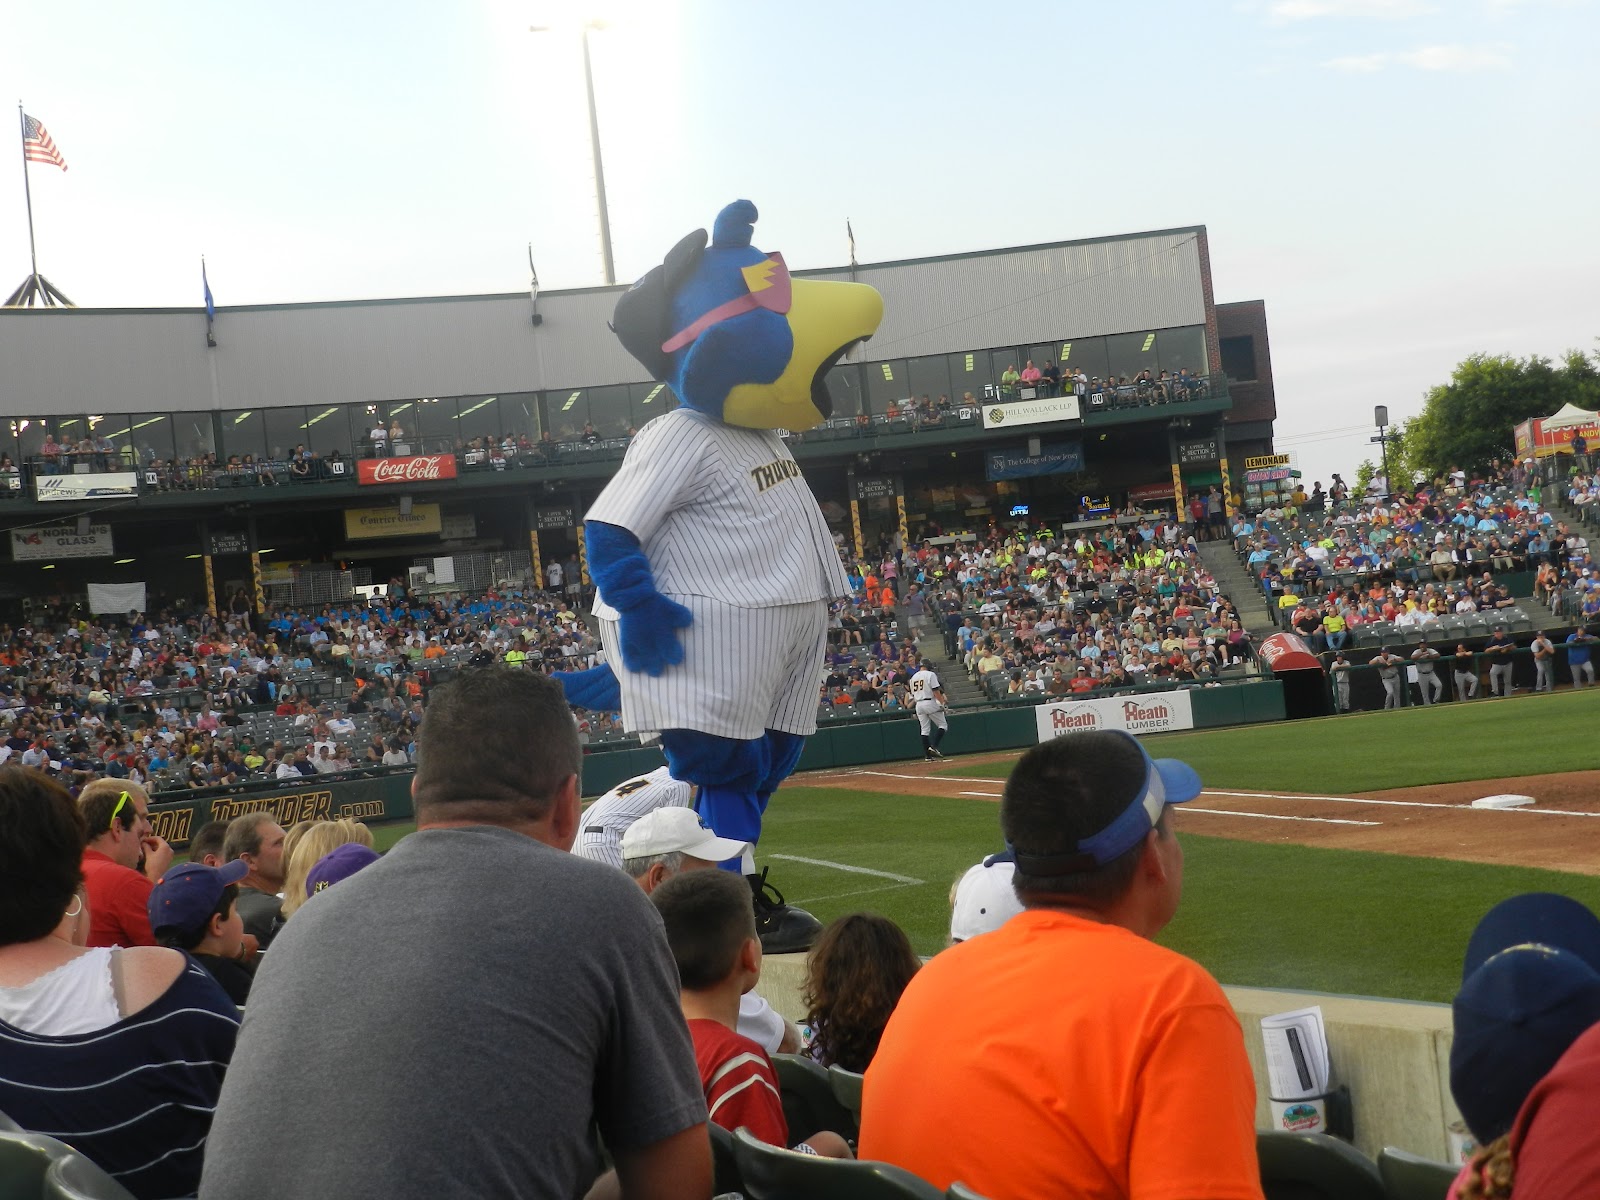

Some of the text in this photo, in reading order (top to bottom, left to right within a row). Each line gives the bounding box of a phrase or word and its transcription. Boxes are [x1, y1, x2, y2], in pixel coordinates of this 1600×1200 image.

[1005, 402, 1072, 416] HILL WALLACK LLP
[1187, 448, 1209, 456] SECTION
[1007, 459, 1018, 467] The
[1019, 457, 1041, 467] College
[1061, 452, 1078, 461] Jersey
[1246, 455, 1289, 468] LEMONADE
[1248, 470, 1290, 481] COTTON CANDY
[864, 485, 887, 493] SECTION
[360, 515, 395, 526] Courier
[43, 526, 108, 537] NORMN'S
[57, 536, 97, 546] GLASS
[913, 679, 925, 692] 59
[1124, 701, 1168, 721] Heath
[1052, 709, 1096, 729] Heath
[1126, 719, 1169, 730] LUMBER
